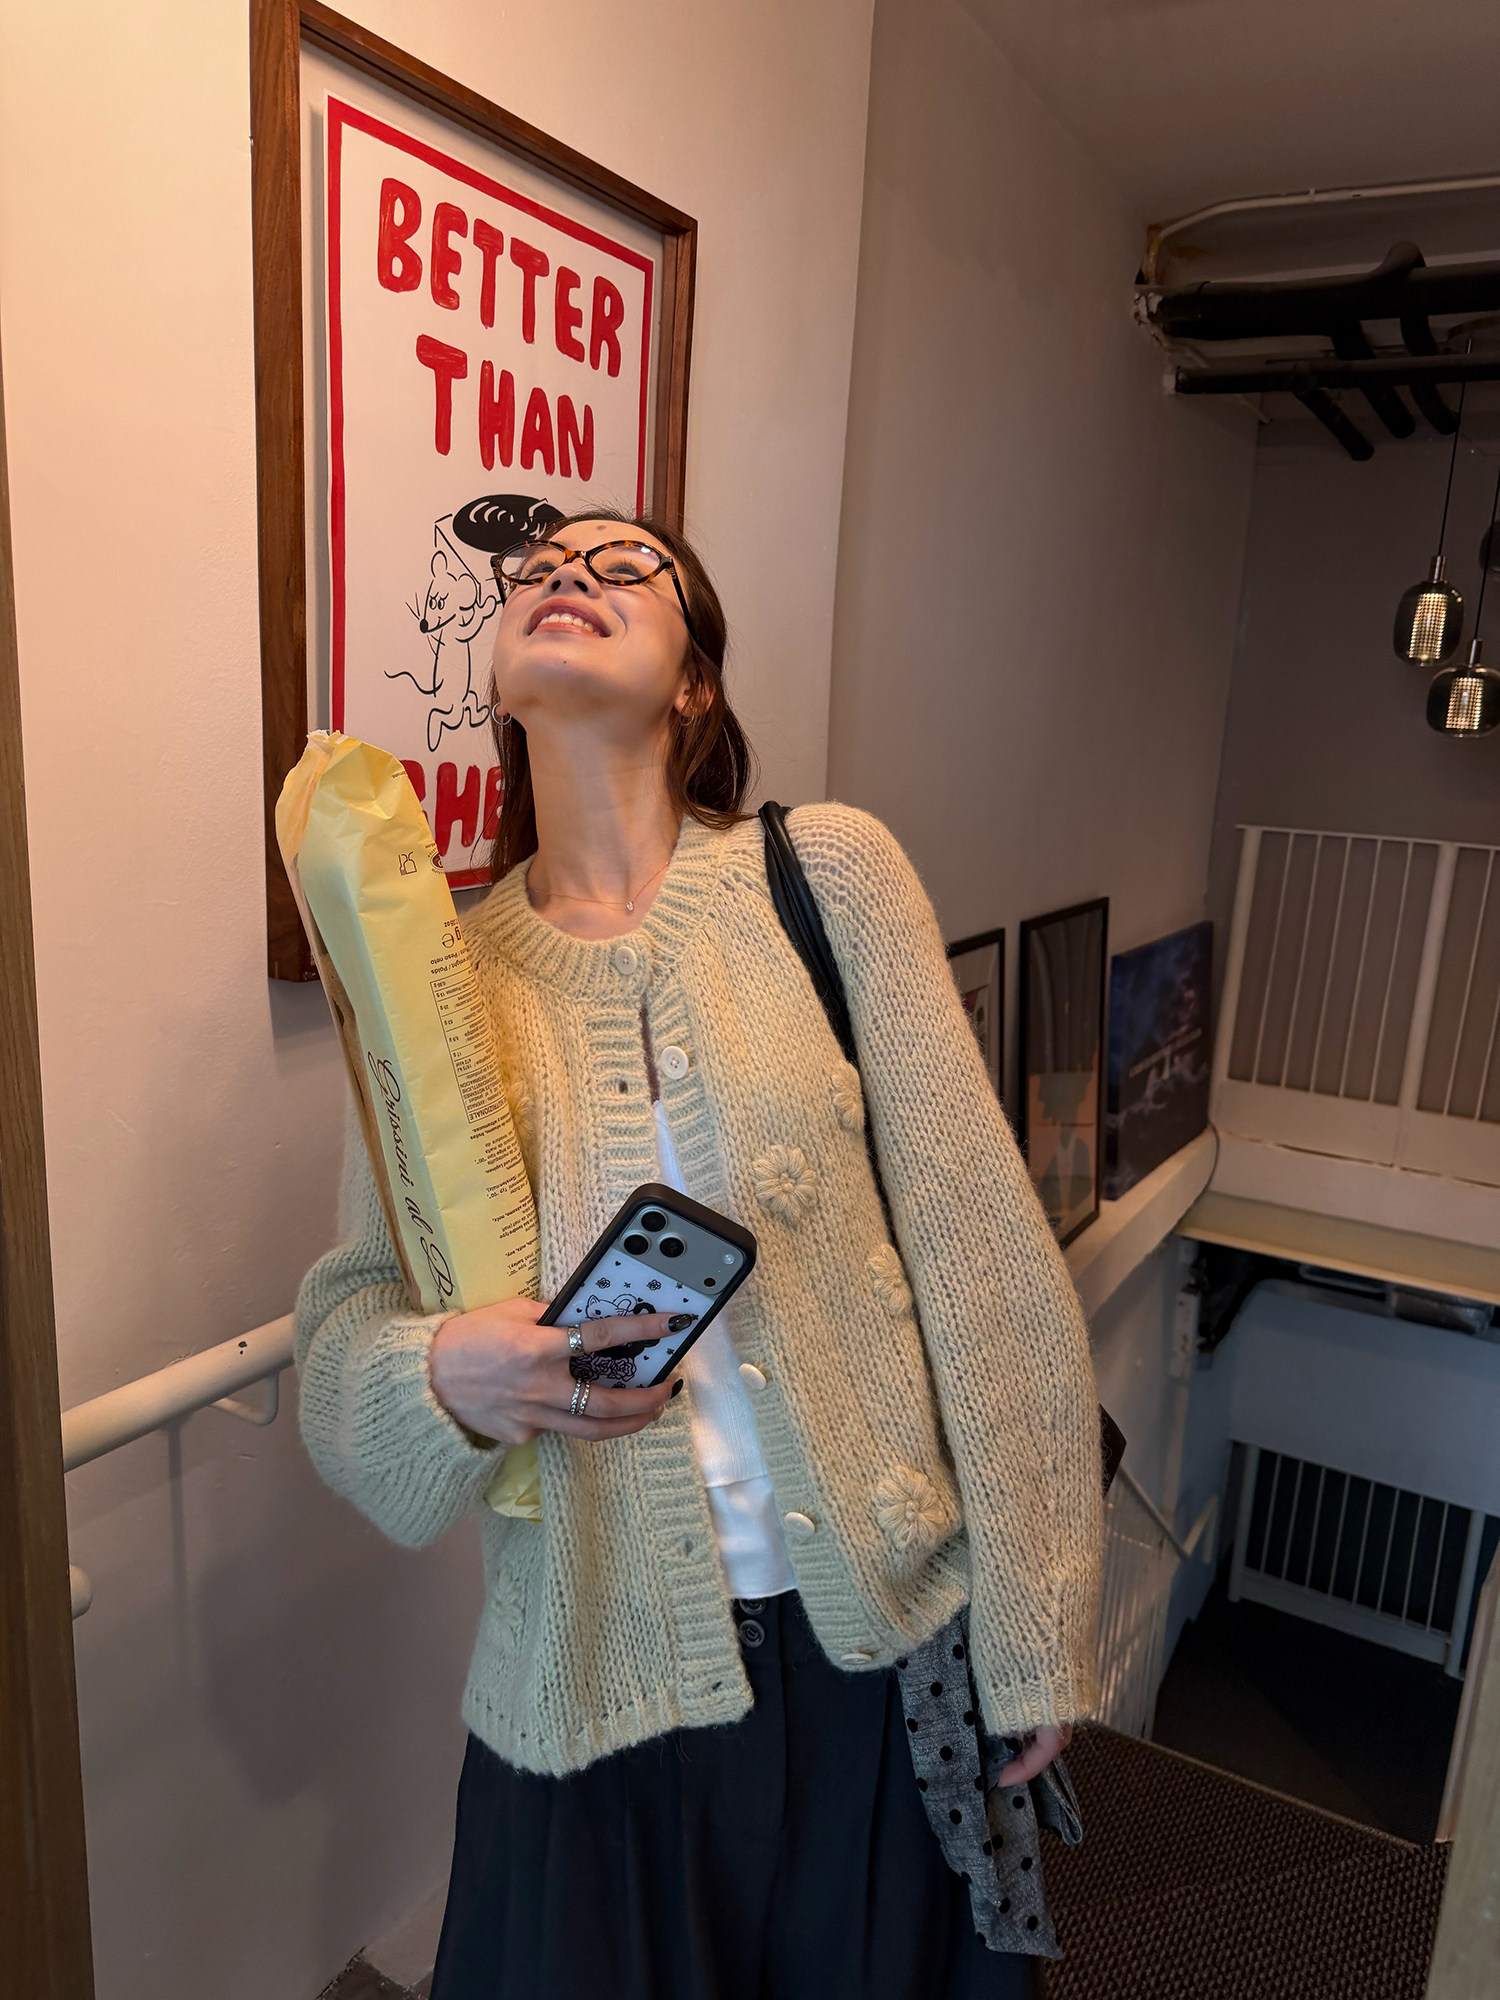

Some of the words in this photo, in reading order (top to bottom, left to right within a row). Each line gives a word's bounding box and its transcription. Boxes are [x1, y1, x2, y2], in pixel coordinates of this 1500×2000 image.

[377, 177, 625, 378] BETTER
[416, 334, 595, 482] THAN
[430, 956, 444, 965] neto
[431, 965, 448, 975] Poids
[444, 952, 458, 961] Peso
[368, 1050, 414, 1187] Grissini
[404, 1196, 434, 1234] al
